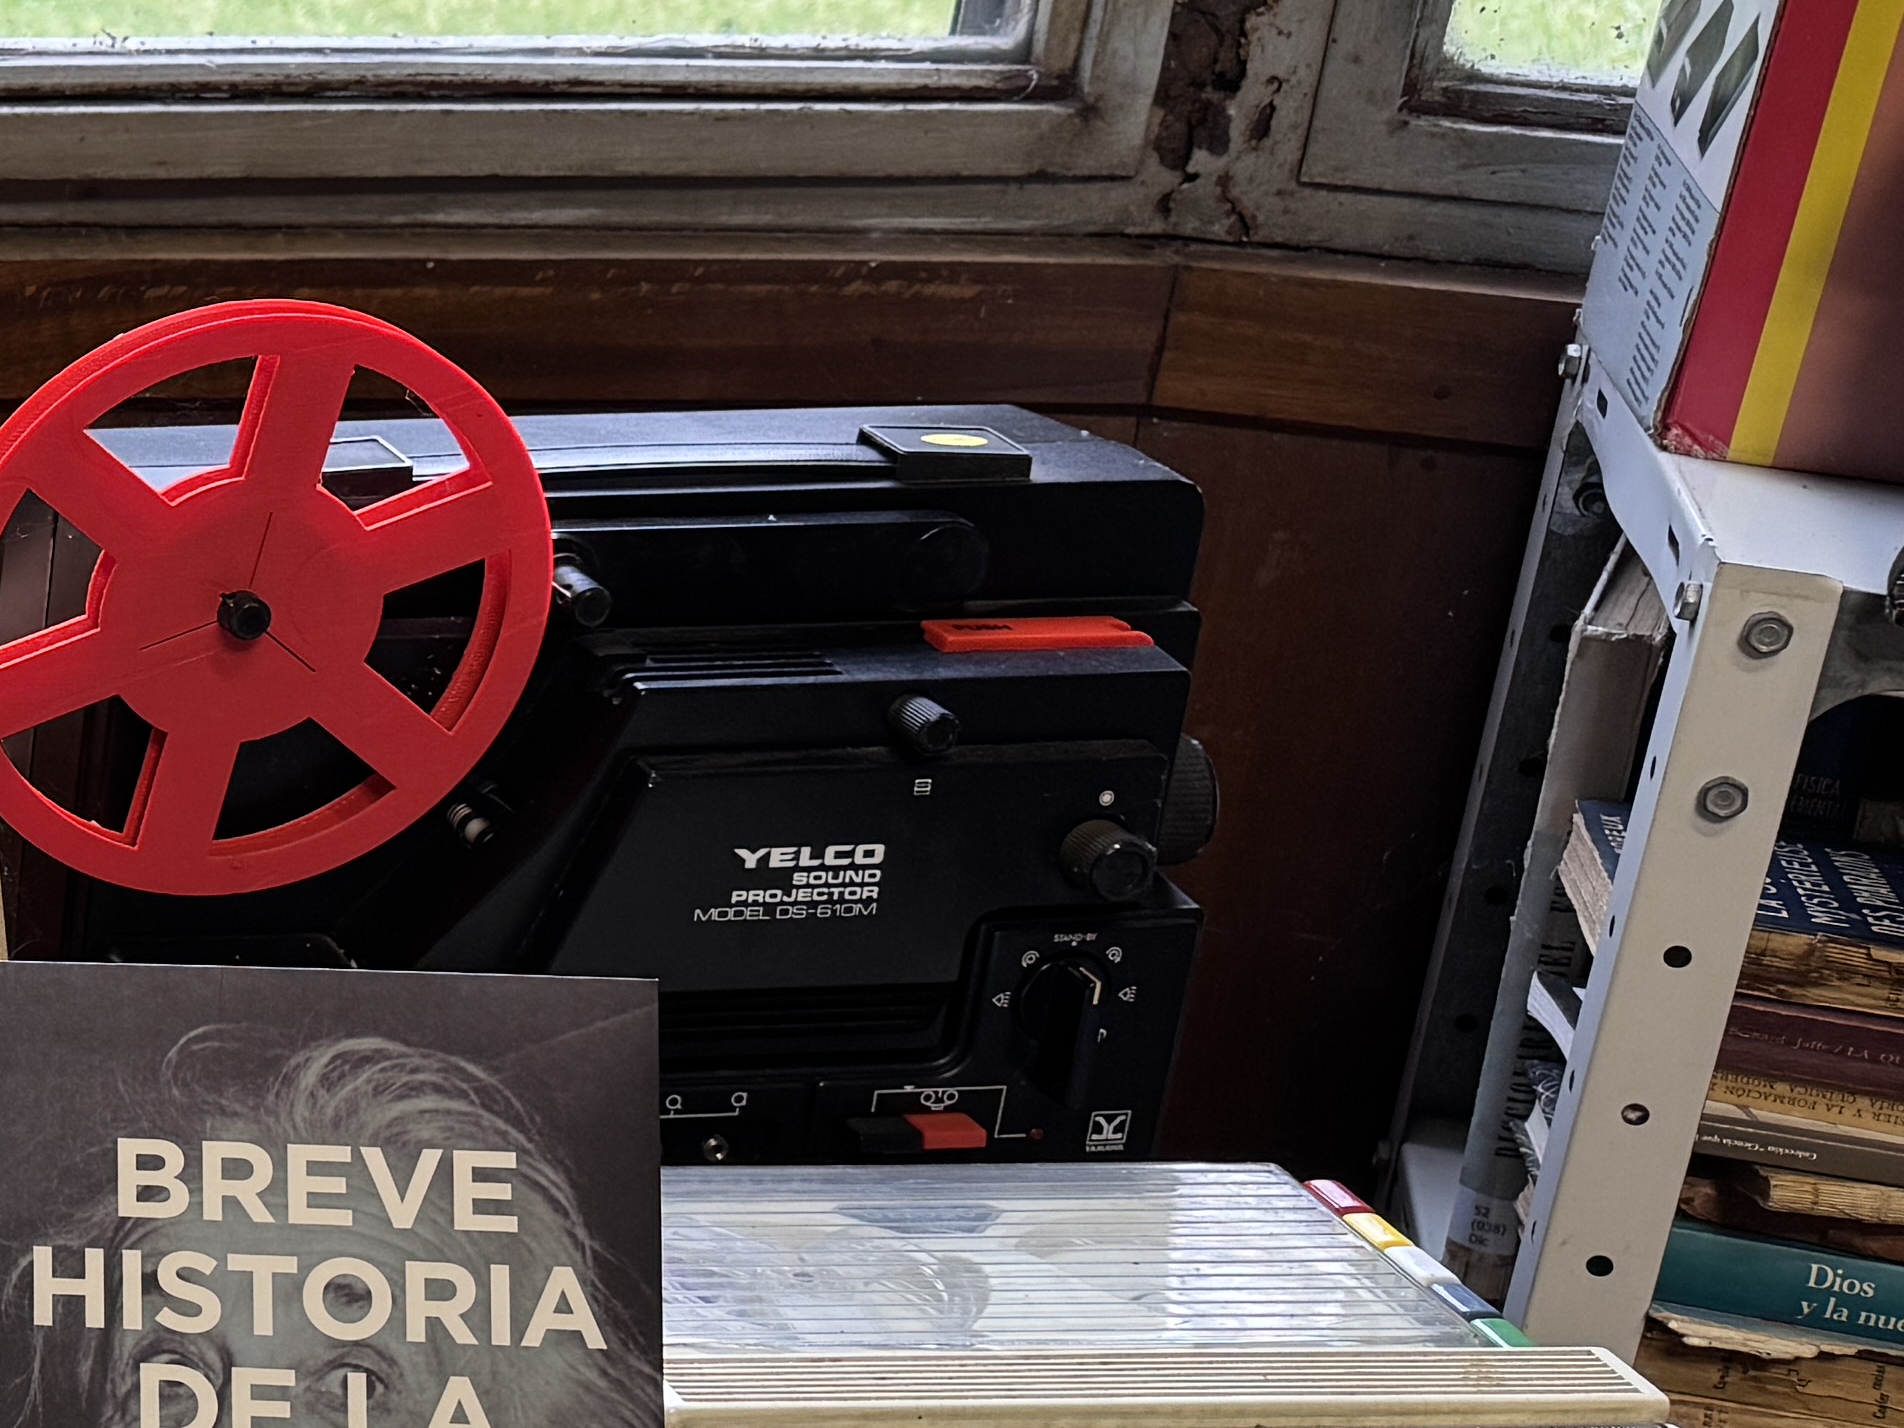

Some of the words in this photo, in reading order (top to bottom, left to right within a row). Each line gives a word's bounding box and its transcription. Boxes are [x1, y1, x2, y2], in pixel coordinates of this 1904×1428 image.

[733, 844, 886, 869] YELCO
[792, 869, 882, 885] SOUND
[731, 886, 880, 904] PROJECTOR
[694, 906, 771, 922] MODEL
[776, 902, 878, 919] DS-610M
[1723, 1085, 1818, 1111] FORMACIÓN
[115, 1137, 521, 1234] BREVE
[1806, 1263, 1876, 1298] Dios
[31, 1245, 608, 1351] HISTORIA
[1794, 1301, 1818, 1320] y
[1823, 1297, 1848, 1322] la
